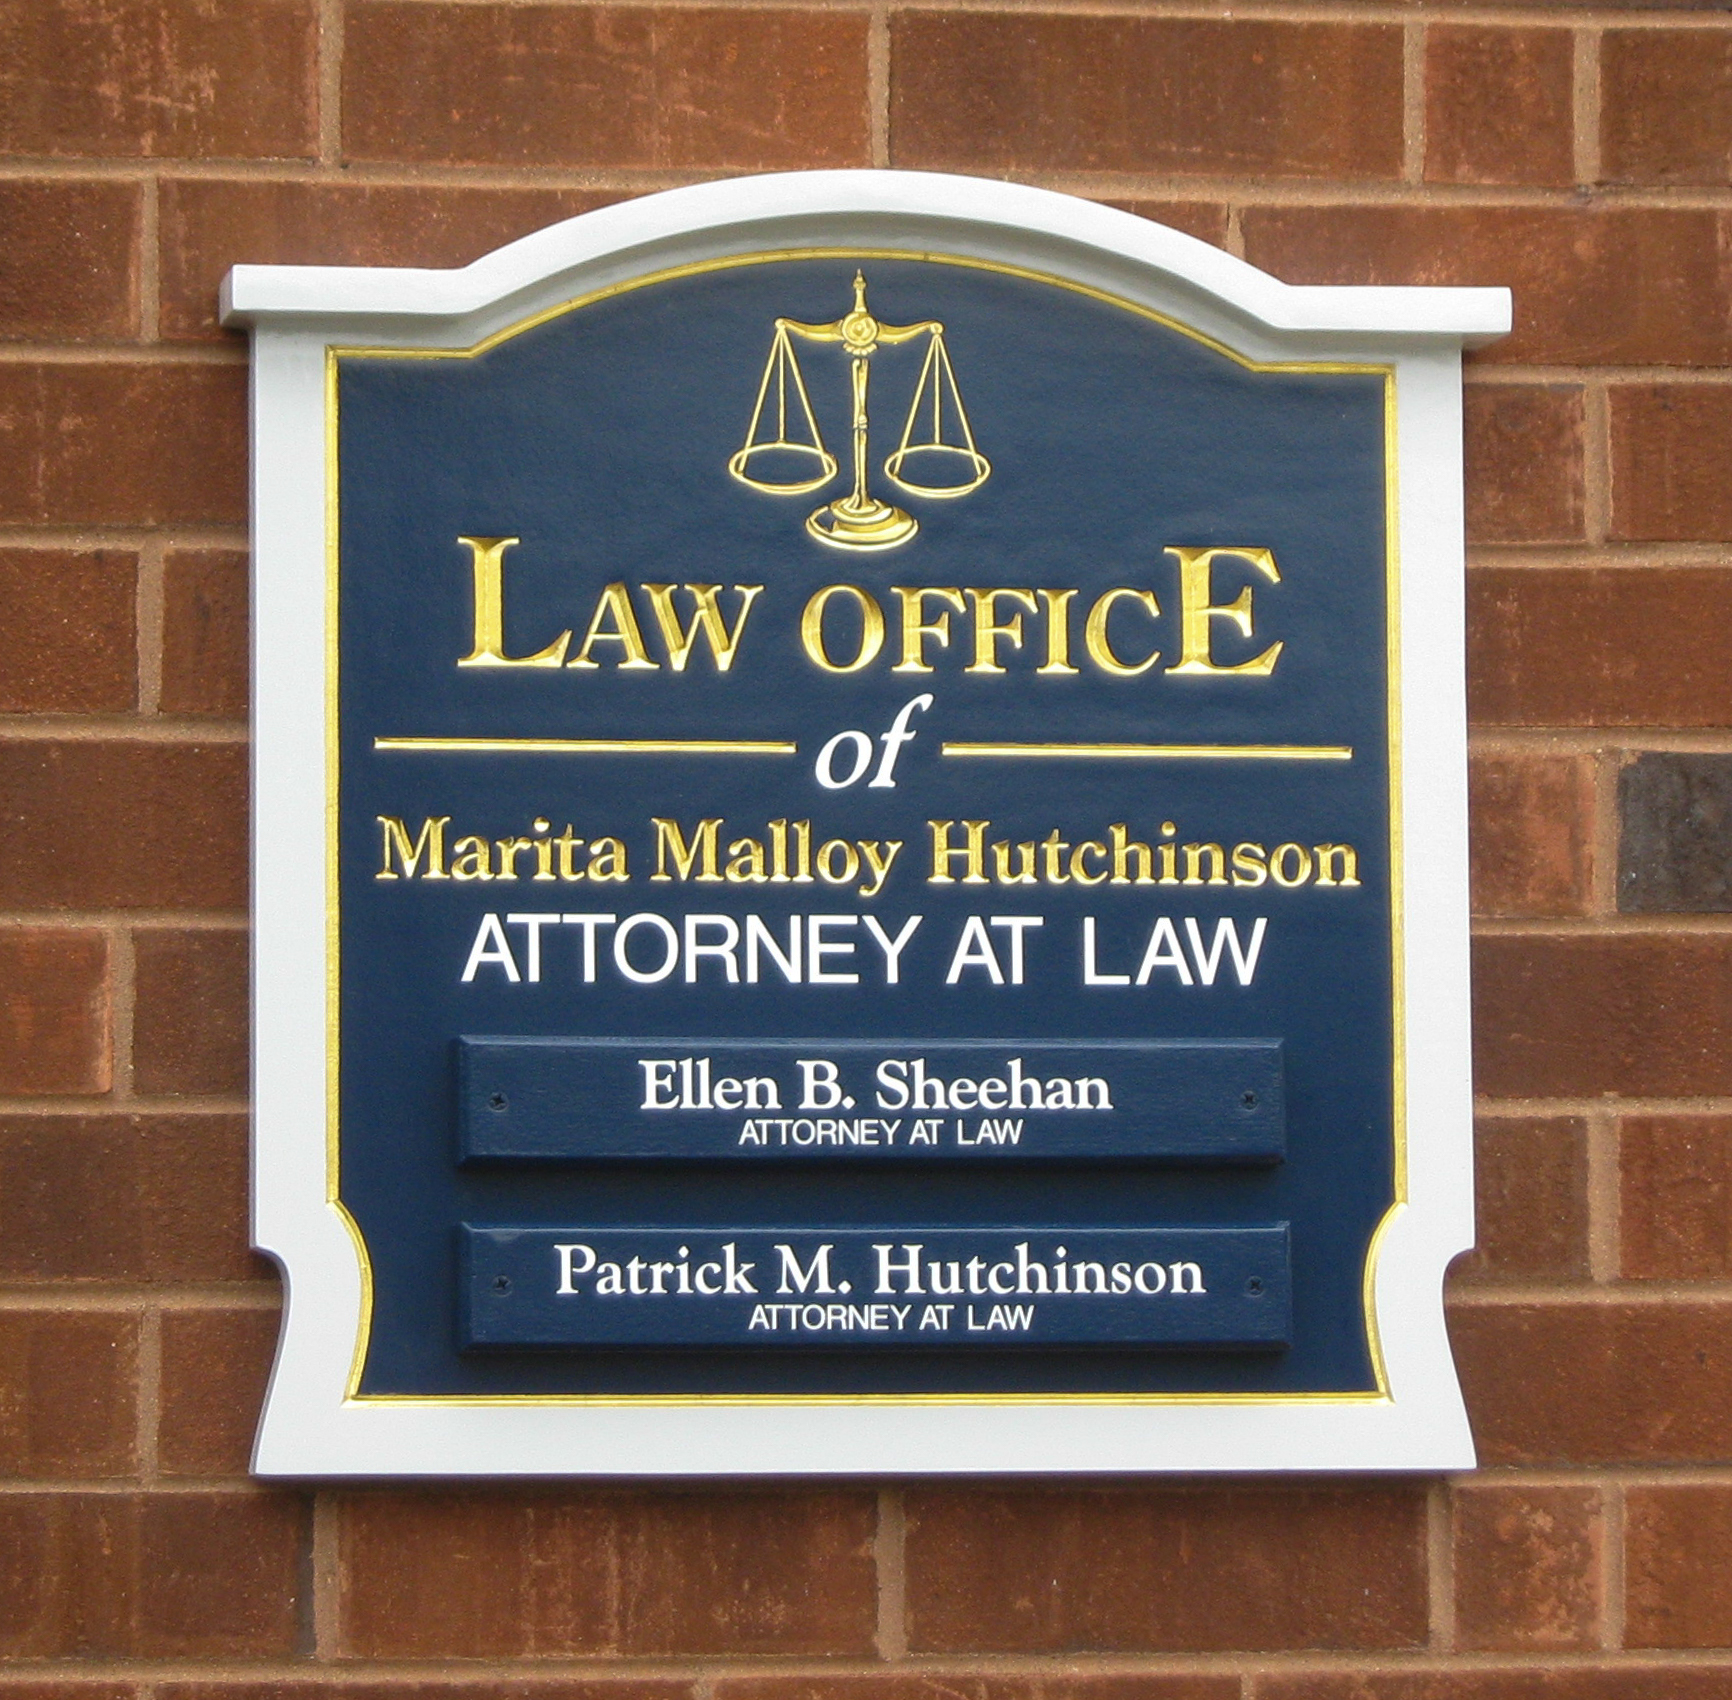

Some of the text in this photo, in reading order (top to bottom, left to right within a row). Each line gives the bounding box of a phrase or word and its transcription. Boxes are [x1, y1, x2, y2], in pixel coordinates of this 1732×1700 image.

[457, 537, 1283, 677] LAW OFFICE
[815, 694, 933, 789] of
[376, 816, 1361, 897] Marita Malloy Hutchinson
[461, 913, 1267, 986] ATTORNEY AT LAW
[638, 1058, 1113, 1110] Ellen B. Sheehan
[739, 1119, 1023, 1145] ATTORNEY AT LAW
[554, 1242, 1206, 1294] Patrick M. Hutchinson
[749, 1304, 1034, 1330] ATTORNEY AT LAW
